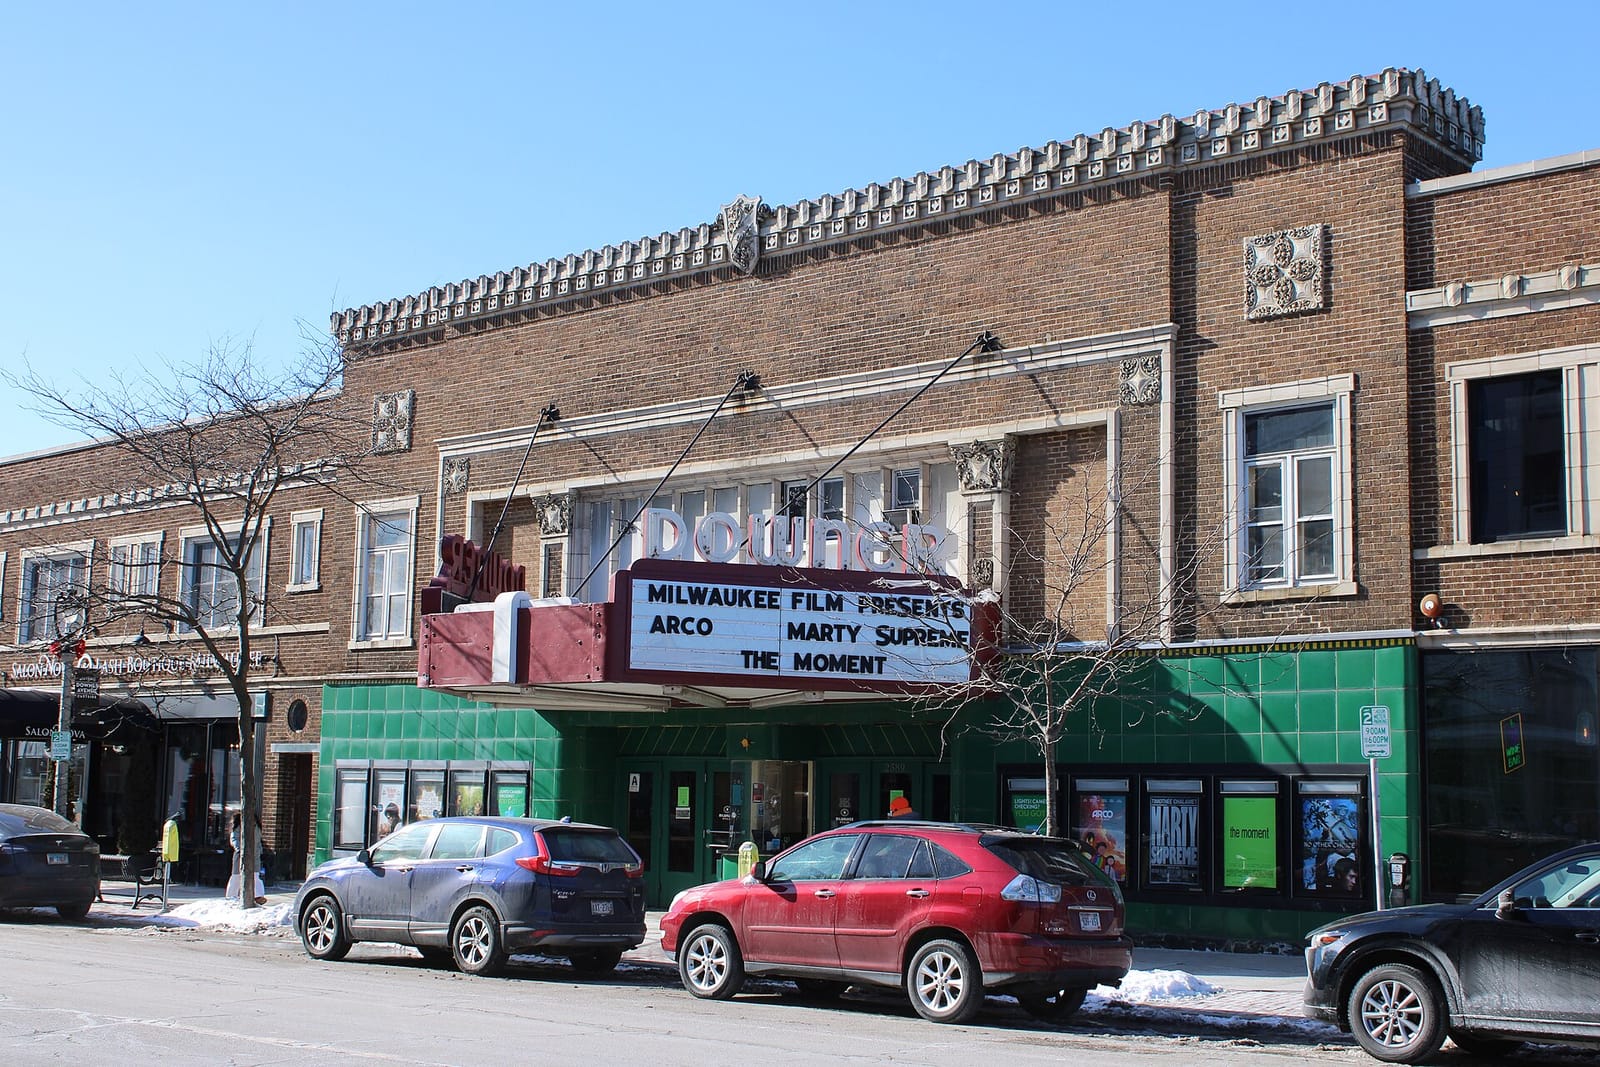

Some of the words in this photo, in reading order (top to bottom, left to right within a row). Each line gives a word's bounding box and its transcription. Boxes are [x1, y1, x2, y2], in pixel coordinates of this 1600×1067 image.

[648, 584, 781, 610] MILWAUKEE
[791, 592, 844, 612] FILM
[858, 595, 965, 619] PRESENTS
[650, 615, 714, 636] ARCO
[787, 622, 862, 644] MARTY
[875, 625, 969, 649] SUPREME
[741, 650, 779, 670] THE
[793, 653, 888, 675] MOMENT
[1363, 711, 1372, 724] 2
[631, 775, 638, 786] A
[1092, 810, 1113, 818] ARCO
[1151, 806, 1198, 847] MARTY
[1229, 826, 1240, 839] the
[1241, 827, 1270, 840] moment
[1151, 846, 1198, 865] SUPREME
